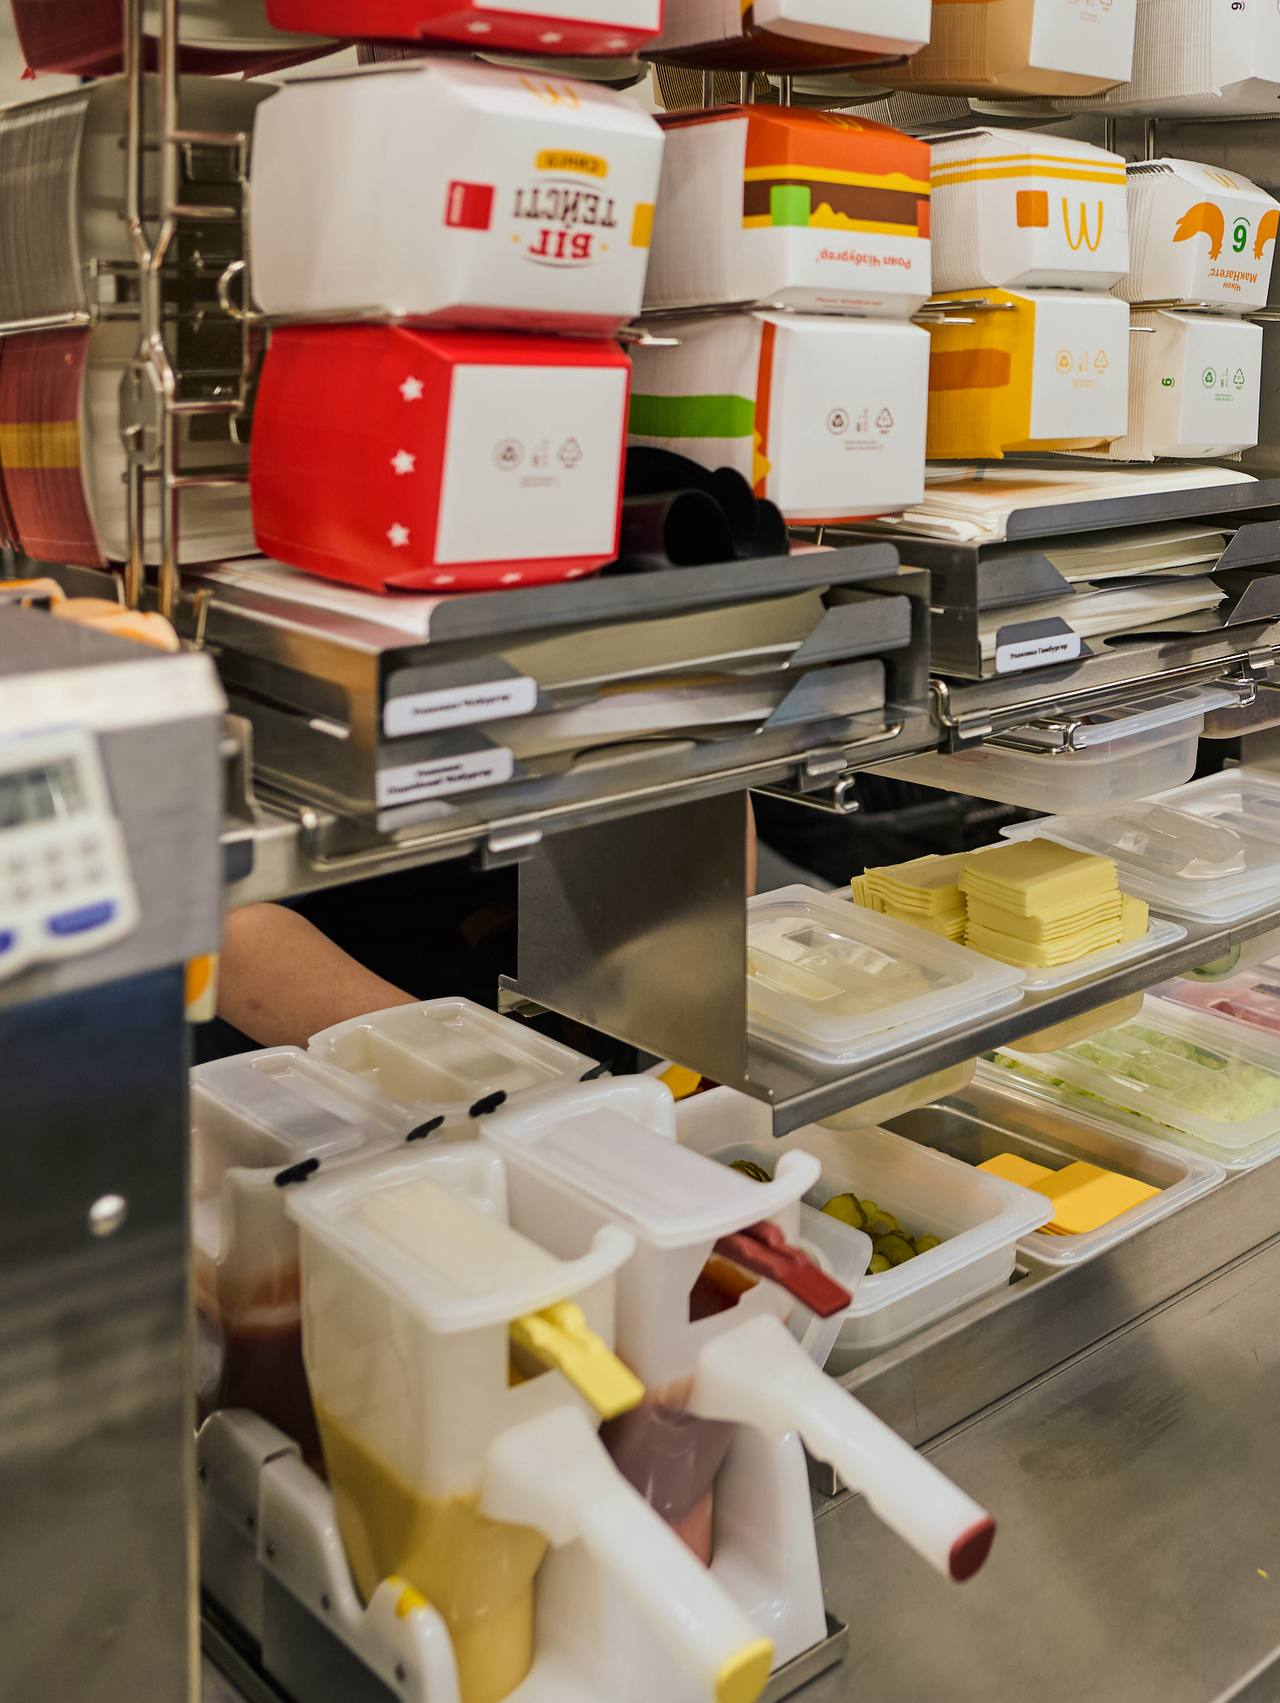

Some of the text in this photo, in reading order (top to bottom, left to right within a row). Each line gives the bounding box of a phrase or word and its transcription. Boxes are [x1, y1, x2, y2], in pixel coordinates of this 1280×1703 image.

[512, 189, 617, 229] ТЕЙСТІ
[529, 229, 593, 260] БІГ
[1232, 225, 1246, 253] 6
